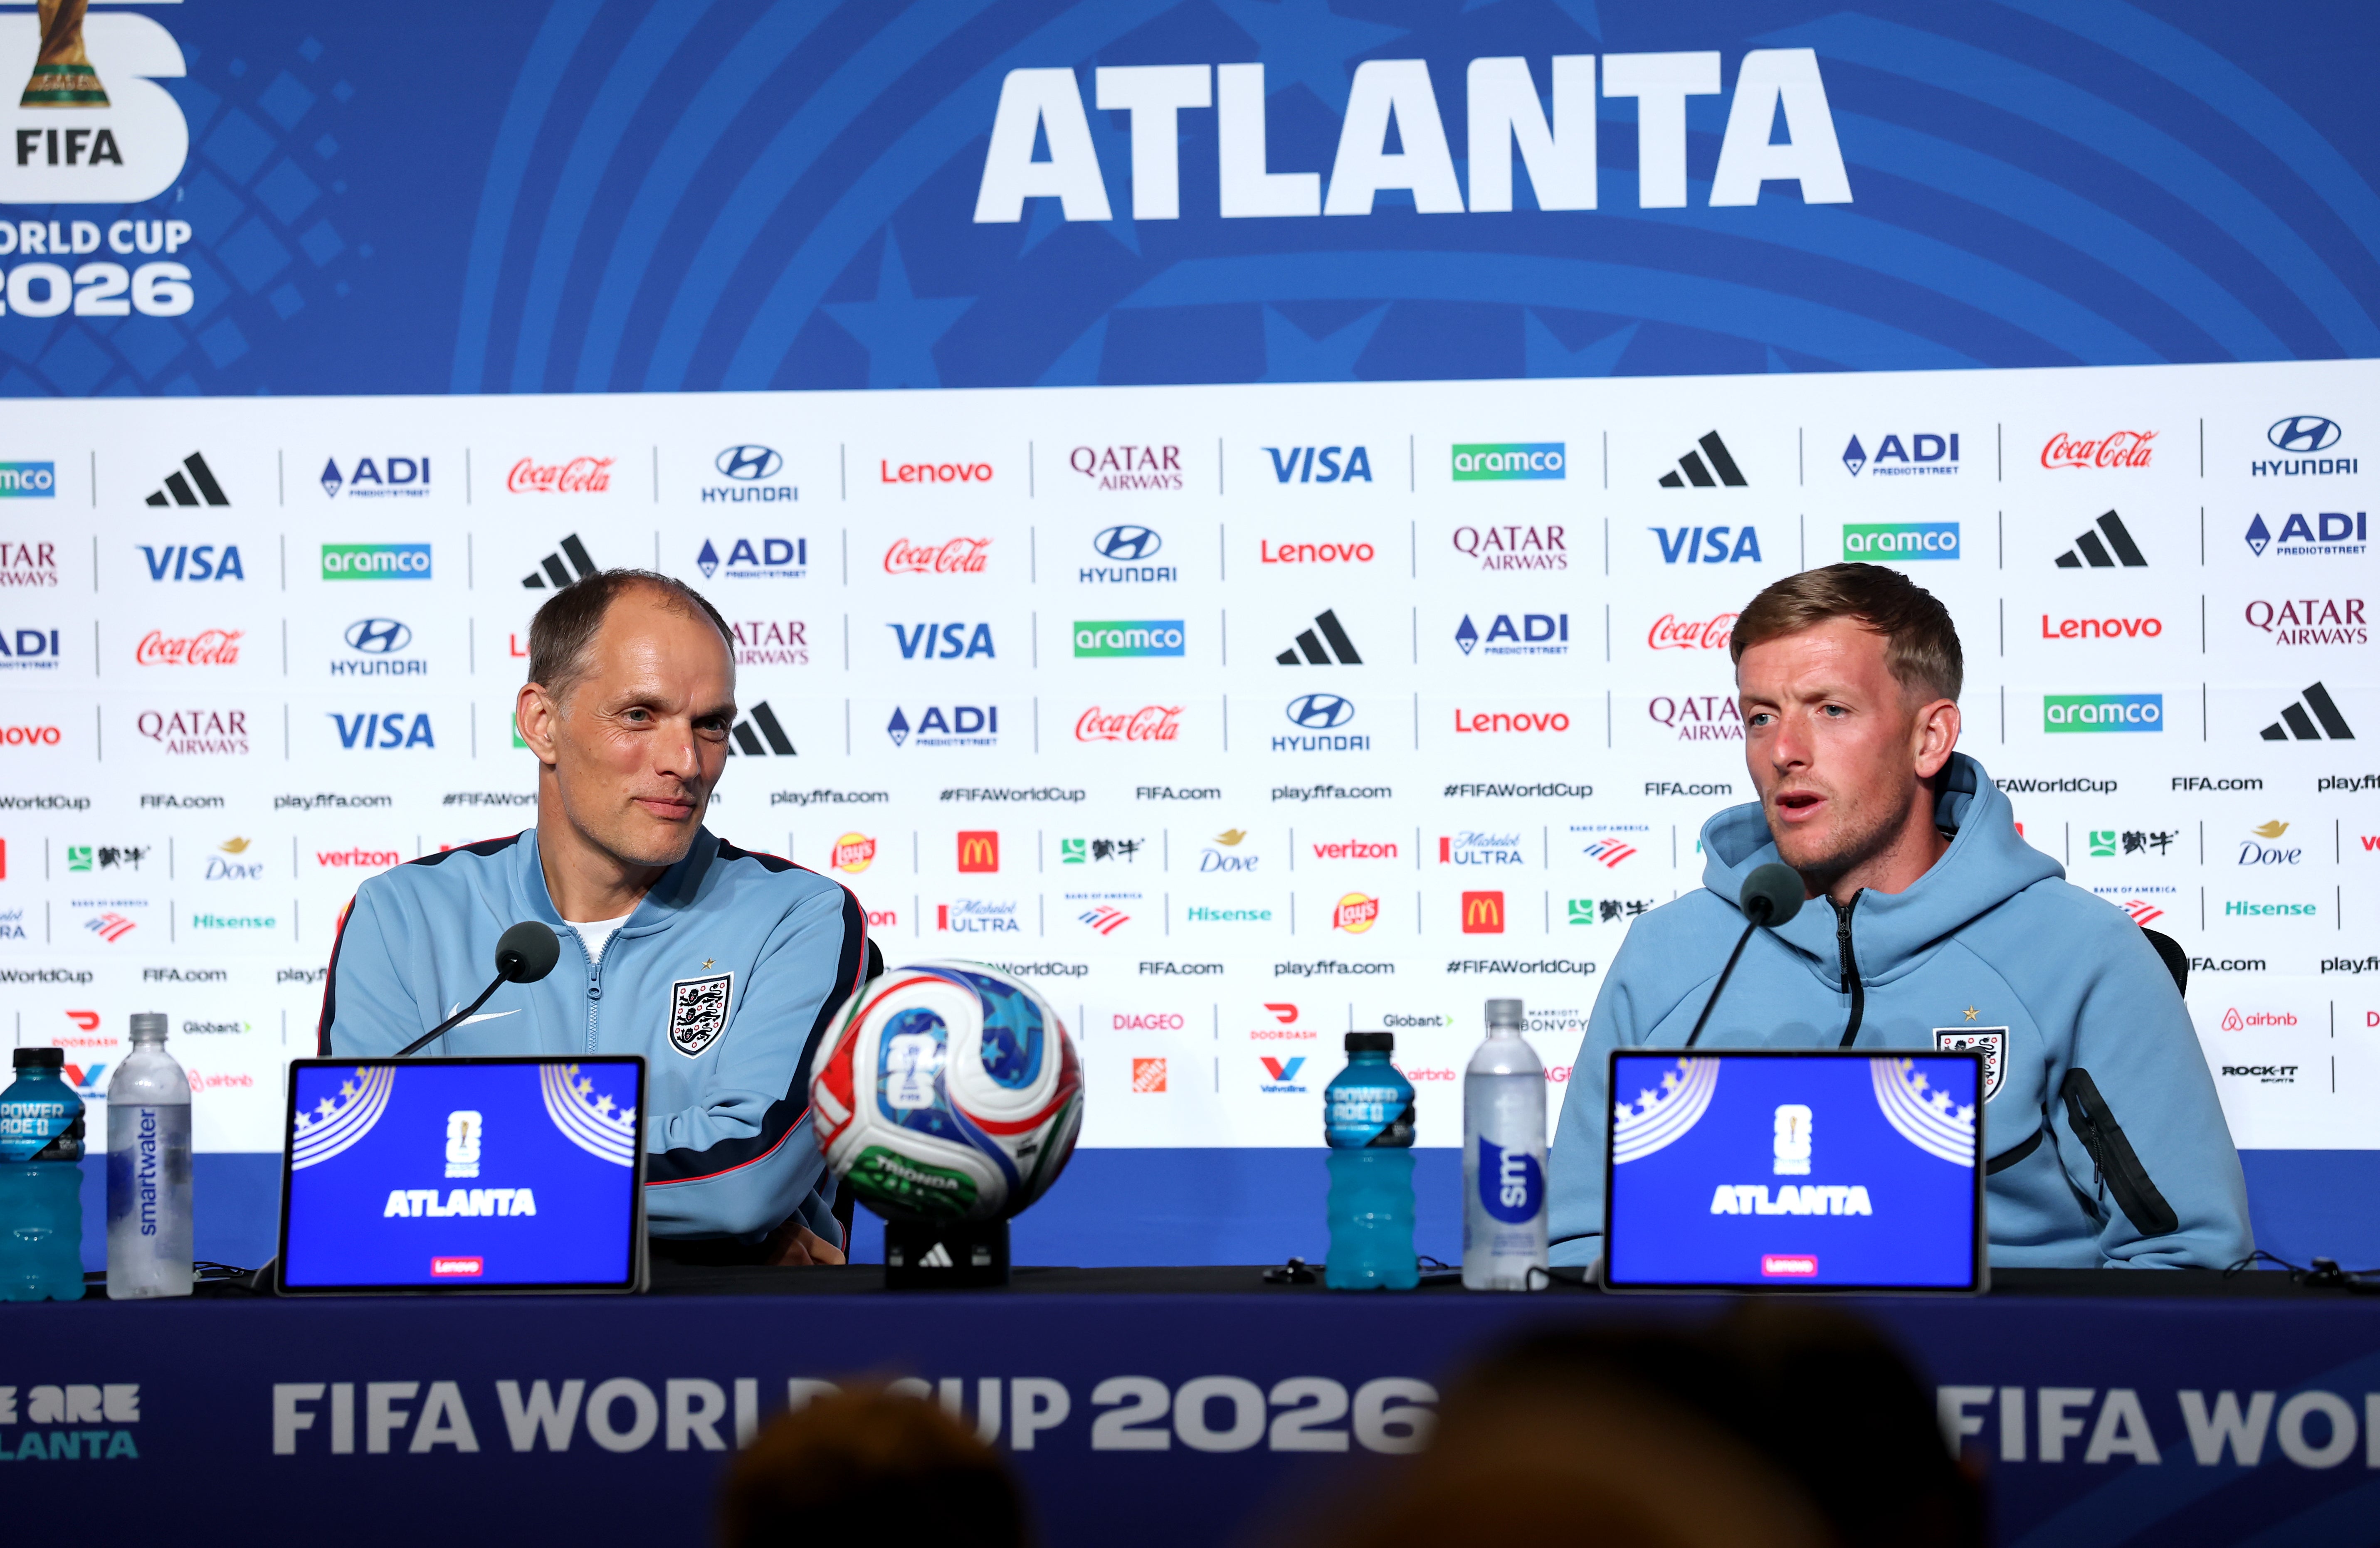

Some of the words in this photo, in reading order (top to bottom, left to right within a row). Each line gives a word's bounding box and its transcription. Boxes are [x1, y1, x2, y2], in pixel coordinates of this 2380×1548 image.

[972, 47, 1854, 224] ATLANTA
[16, 129, 123, 166] FIFA
[108, 220, 192, 254] CUP
[0, 261, 195, 318] 026
[1874, 433, 1959, 463] ADI
[2041, 431, 2157, 469] Coca-Cola
[351, 457, 430, 485] ADI
[1071, 445, 1181, 477] QATAR
[1262, 446, 1373, 483] VISA
[1454, 451, 1563, 472] aramco
[1873, 466, 1958, 476] PREDICTSTREET
[2252, 458, 2357, 476] HYUNDAI
[507, 457, 613, 493] Coca-Cola
[881, 460, 993, 483] Lenovo
[1099, 476, 1183, 491] AIRWAYS
[702, 487, 798, 502] HYUNDAI
[2278, 512, 2366, 542] ADI
[1262, 540, 1374, 563] Lenovo
[1453, 525, 1566, 558] QATAR
[1648, 526, 1762, 564] VISA
[1846, 531, 1957, 552] aramco
[2277, 546, 2366, 555] PREDICTSTREET
[323, 550, 429, 572] aramco
[727, 538, 806, 566] ADI
[884, 537, 990, 574] Coca-Cola
[139, 545, 244, 581] VISA
[1482, 555, 1567, 571] AIRWAYS
[1080, 567, 1176, 583] HYUNDAI
[2245, 599, 2366, 632] QATAR
[734, 621, 807, 646] ATAR
[1486, 614, 1568, 642] ADI
[1649, 613, 1739, 650] Coca-Co
[2042, 615, 2162, 638] Lenovo
[136, 630, 242, 665] Coca-Cola
[887, 623, 995, 659] VISA
[1076, 629, 1183, 648] aramco
[2276, 629, 2368, 646] AIRWAYS
[331, 660, 427, 675] HYUNDAI
[918, 706, 997, 734] ADI
[1456, 709, 1569, 732] Lenovo
[1649, 696, 1740, 727] QATA
[2047, 703, 2160, 724] aramco
[137, 710, 247, 741] QATAR
[330, 713, 435, 749] VISA
[1075, 706, 1183, 742] Coca-Cola
[1679, 725, 1744, 741] AIRWA
[166, 740, 249, 755] AIRWAYS
[1272, 736, 1370, 751] HYUNDAI
[1136, 787, 1221, 800] FIFA.com
[1272, 785, 1392, 802] play.fifa.com
[1444, 783, 1593, 799] #FIFAWorldCup
[1645, 782, 1732, 796] FIFA.com
[1994, 777, 2117, 794] FAWorldCup
[2172, 777, 2262, 790] FIFA.com
[141, 795, 224, 808] FIFA.com
[274, 794, 392, 811] play.fifa.com
[771, 789, 889, 806] play.fifa.com
[940, 787, 1085, 803] #FIFAWorldCup
[317, 846, 399, 866] verizon
[1313, 839, 1397, 858] verizon
[1454, 850, 1523, 865] ULTRA
[2239, 842, 2301, 865] Dove
[205, 853, 263, 880] Dove
[1200, 846, 1259, 872] Dove
[1188, 907, 1271, 921] Hisense
[2226, 901, 2316, 915] Hisense
[193, 915, 276, 928] Hisense
[952, 918, 1020, 932] ULTRA
[1139, 962, 1224, 975] FIFA.com
[1275, 960, 1395, 977] play.fifa.com
[1447, 960, 1596, 976] #FIFAWorldCup
[2188, 957, 2266, 971] IFA.com
[143, 968, 227, 982] FIFA.com
[183, 1021, 241, 1034] Globant
[1113, 1014, 1184, 1030] DIAGEO
[1383, 1014, 1443, 1027] Globant
[2246, 1013, 2297, 1025] airbnb
[52, 1038, 118, 1047] DOORDASH
[1250, 1030, 1317, 1040] DOORDASH
[1408, 1068, 1456, 1081] airbnb
[2222, 1066, 2298, 1076] ROCK-IT
[205, 1075, 253, 1088] airbnb
[1, 1103, 64, 1119] POWER
[138, 1109, 156, 1236] smartwater
[1500, 1146, 1528, 1208] sm
[384, 1188, 536, 1218] ATLANTA
[1710, 1185, 1872, 1215] ATLANTA
[0, 1385, 17, 1424] E
[273, 1381, 479, 1455] FIFA
[1091, 1375, 1439, 1454] 2026
[1936, 1385, 2161, 1465] FIFA
